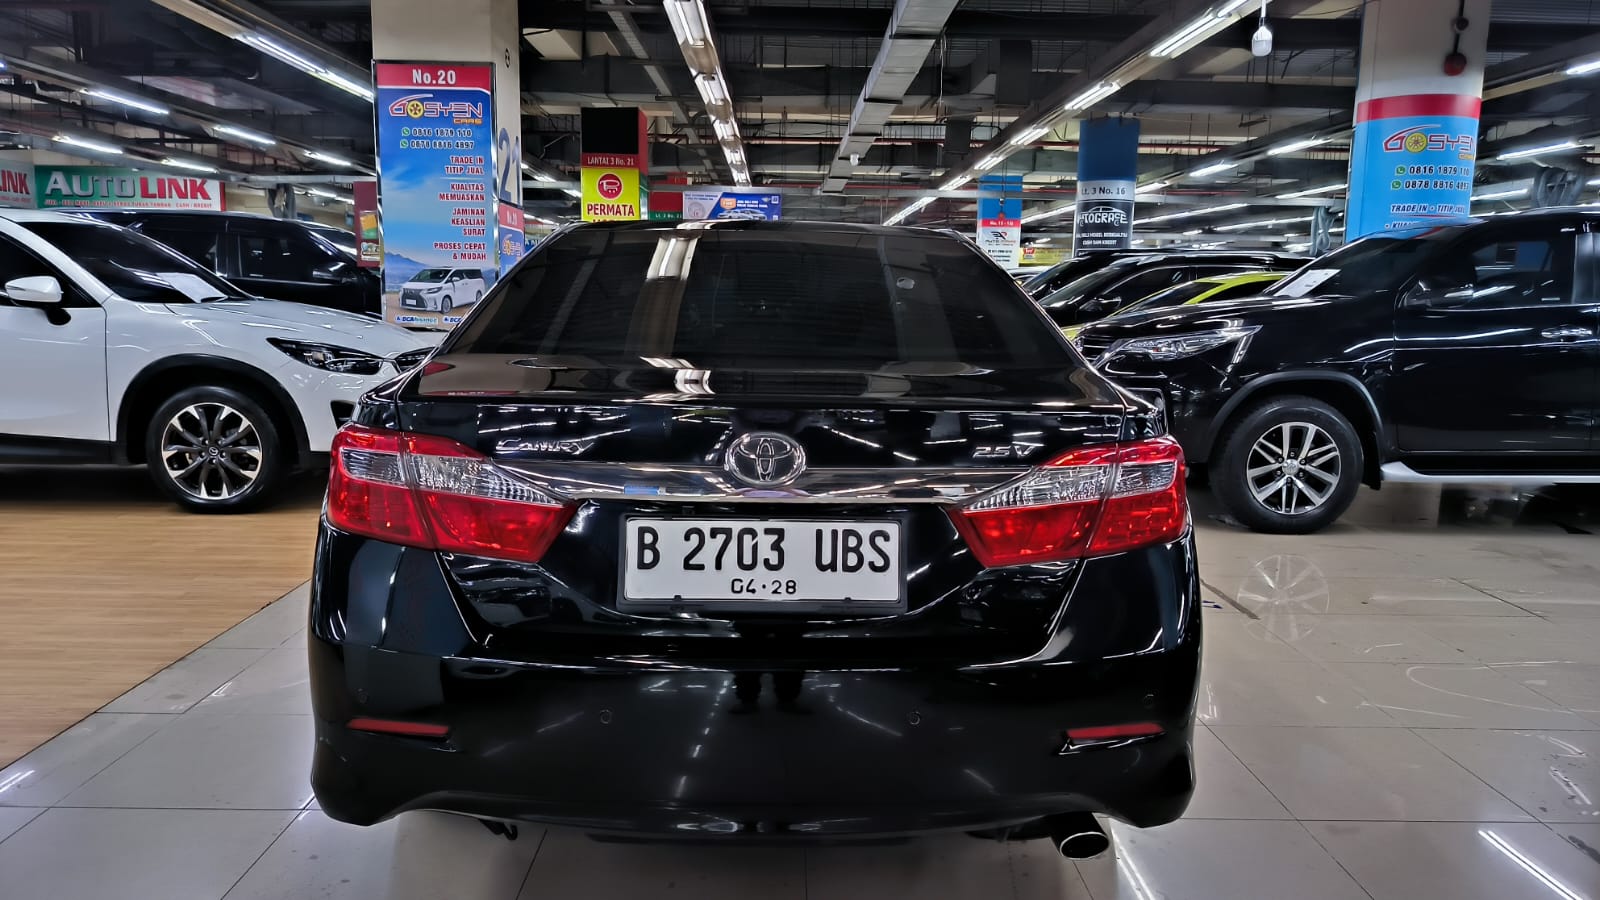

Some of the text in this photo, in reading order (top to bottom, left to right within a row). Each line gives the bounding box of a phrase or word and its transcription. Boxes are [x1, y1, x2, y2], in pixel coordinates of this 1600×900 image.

[412, 69, 456, 85] No.20
[412, 128, 432, 136] 0816
[458, 128, 473, 137] 110
[451, 156, 484, 165] TRADE IN
[1409, 166, 1434, 174] 0816
[1438, 167, 1457, 175] 1879
[0, 169, 30, 195] INK
[45, 170, 212, 200] AUTO LINK
[1404, 180, 1430, 189] 0878
[1433, 181, 1454, 189] 8816
[451, 183, 484, 191] KUALITAS
[1098, 186, 1113, 194] No.
[1116, 187, 1126, 195] 16
[439, 193, 485, 201] MEMUASKAN
[453, 208, 485, 216] JAMINAN
[587, 203, 635, 217] PERMATA
[1391, 204, 1417, 212] TRADE
[1418, 204, 1428, 212] IN
[451, 218, 486, 226] KEASLIAN
[463, 228, 485, 236] SURAT
[434, 242, 486, 250] PROSES CEPAT
[461, 252, 487, 261] MUDAH
[636, 526, 892, 573] B 2703 UBS
